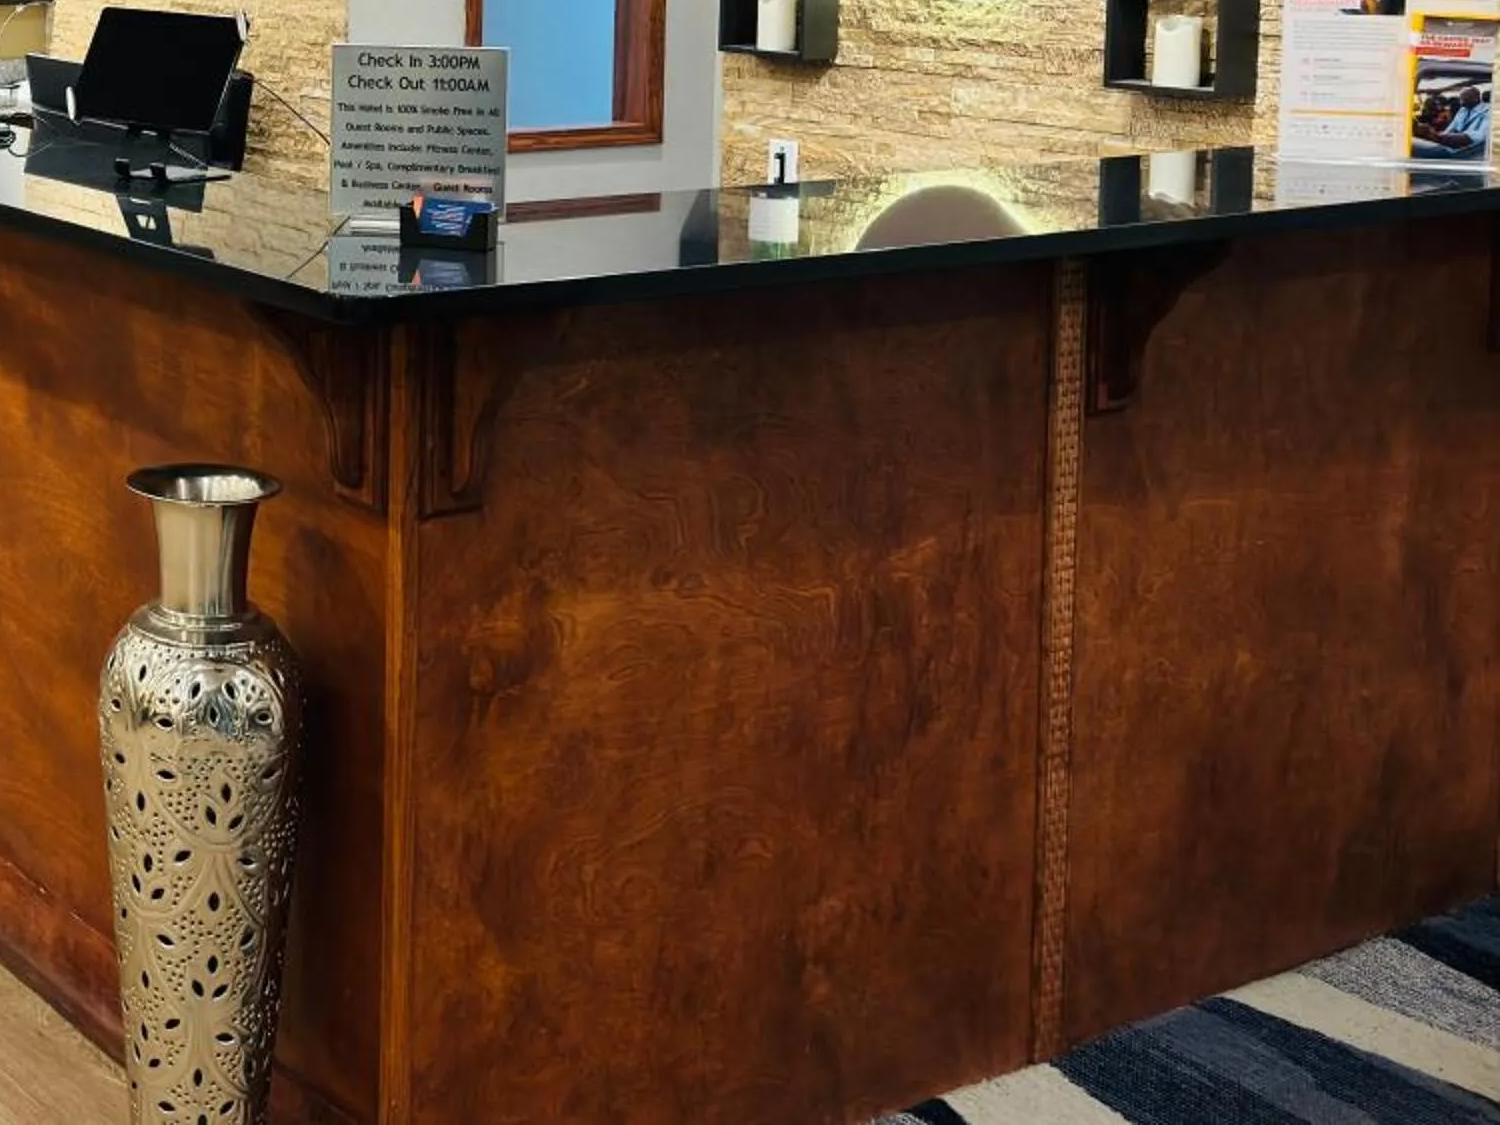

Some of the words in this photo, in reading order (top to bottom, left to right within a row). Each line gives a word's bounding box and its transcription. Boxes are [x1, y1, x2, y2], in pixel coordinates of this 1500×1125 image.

[358, 53, 402, 68] Check
[410, 55, 422, 67] In
[429, 55, 480, 69] 3:00PM
[348, 75, 392, 89] Check
[400, 77, 425, 91] Out
[434, 78, 490, 91] 11:00AM
[338, 102, 355, 112] This
[398, 104, 418, 114] 100%
[421, 106, 449, 115] Smoke
[454, 108, 472, 116] Free
[345, 123, 371, 132] Guest
[375, 124, 402, 133] Rooms
[407, 124, 424, 133] and
[427, 124, 454, 134] Public
[341, 142, 385, 152] Amenities
[426, 144, 458, 154] Fitness
[433, 183, 459, 193] Guest
[463, 184, 493, 194] Rooms
